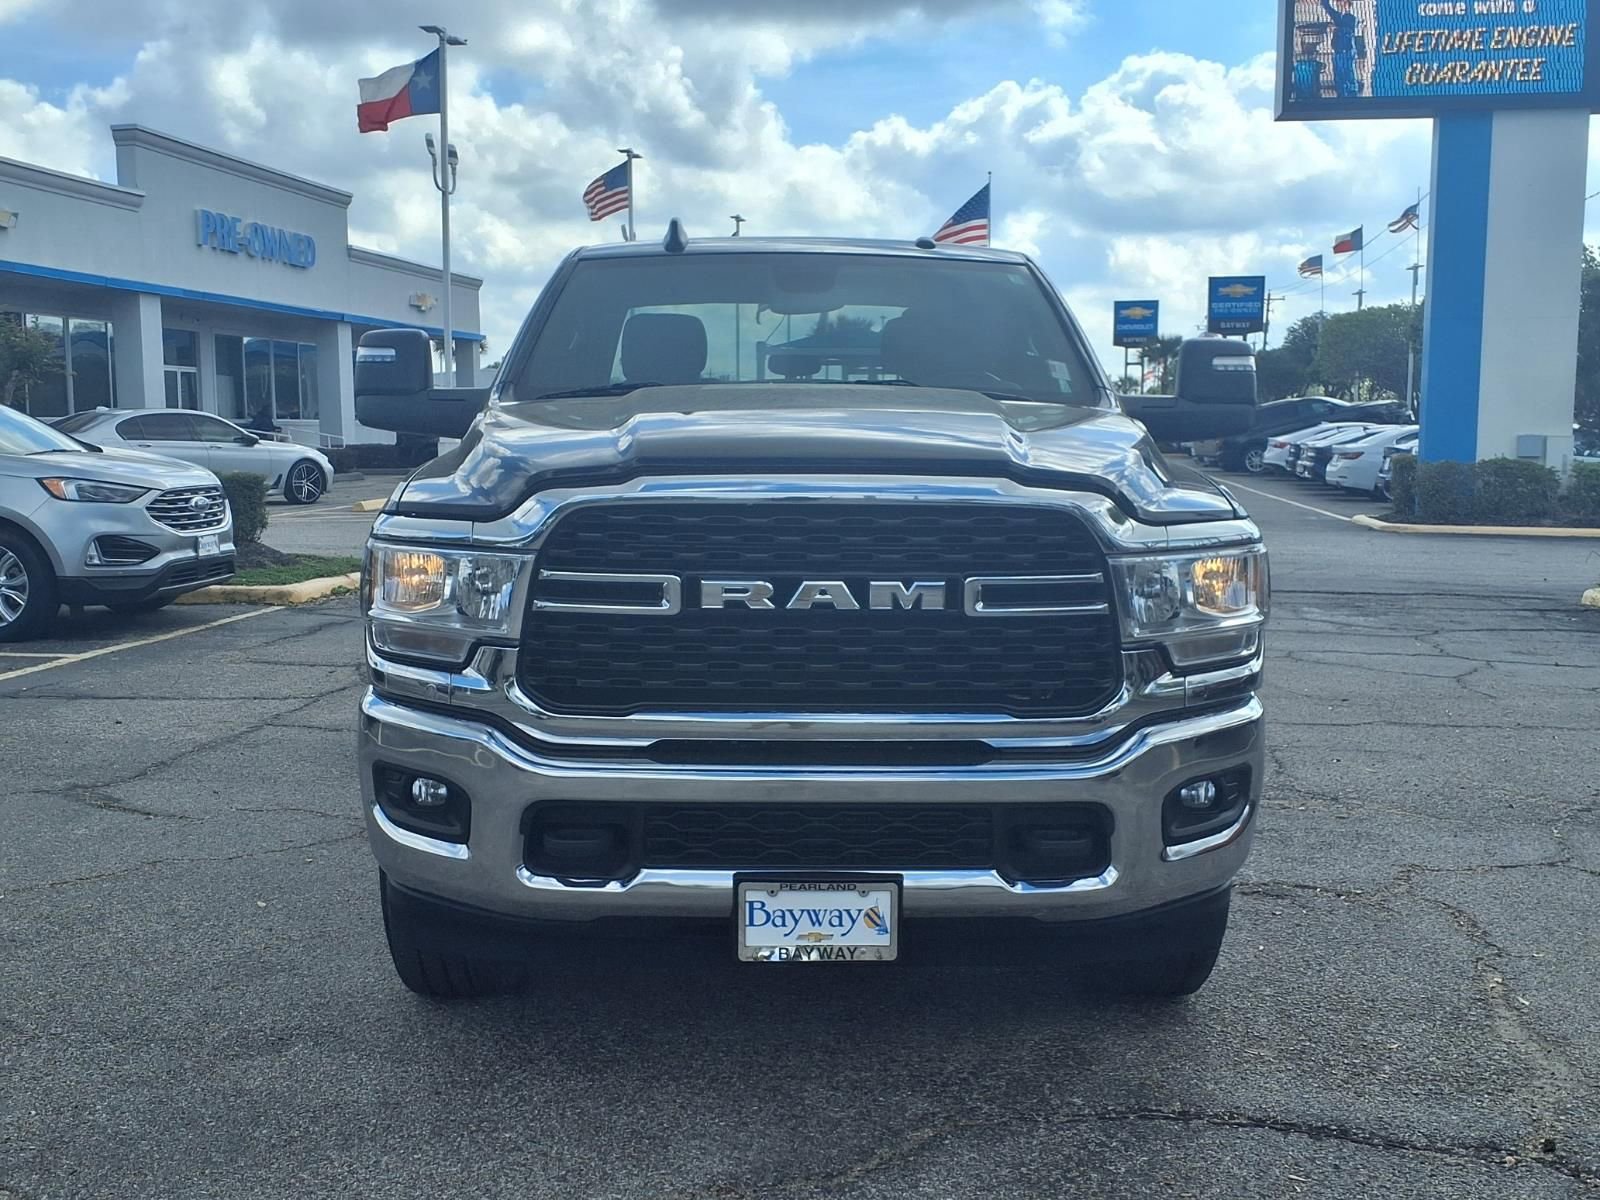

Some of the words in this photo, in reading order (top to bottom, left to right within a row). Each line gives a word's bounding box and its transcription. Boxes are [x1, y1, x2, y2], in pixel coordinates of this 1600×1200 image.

[1382, 27, 1489, 54] LIFETIME
[1489, 22, 1579, 49] ENGINE
[1404, 57, 1547, 86] GUARANTEE
[194, 207, 316, 269] PRE-OWNED
[1220, 321, 1250, 329] BAYWAY
[701, 580, 946, 610] RAM
[779, 883, 857, 892] PEARLAND
[745, 900, 864, 937] Bayway
[778, 947, 857, 961] BAYWAY
